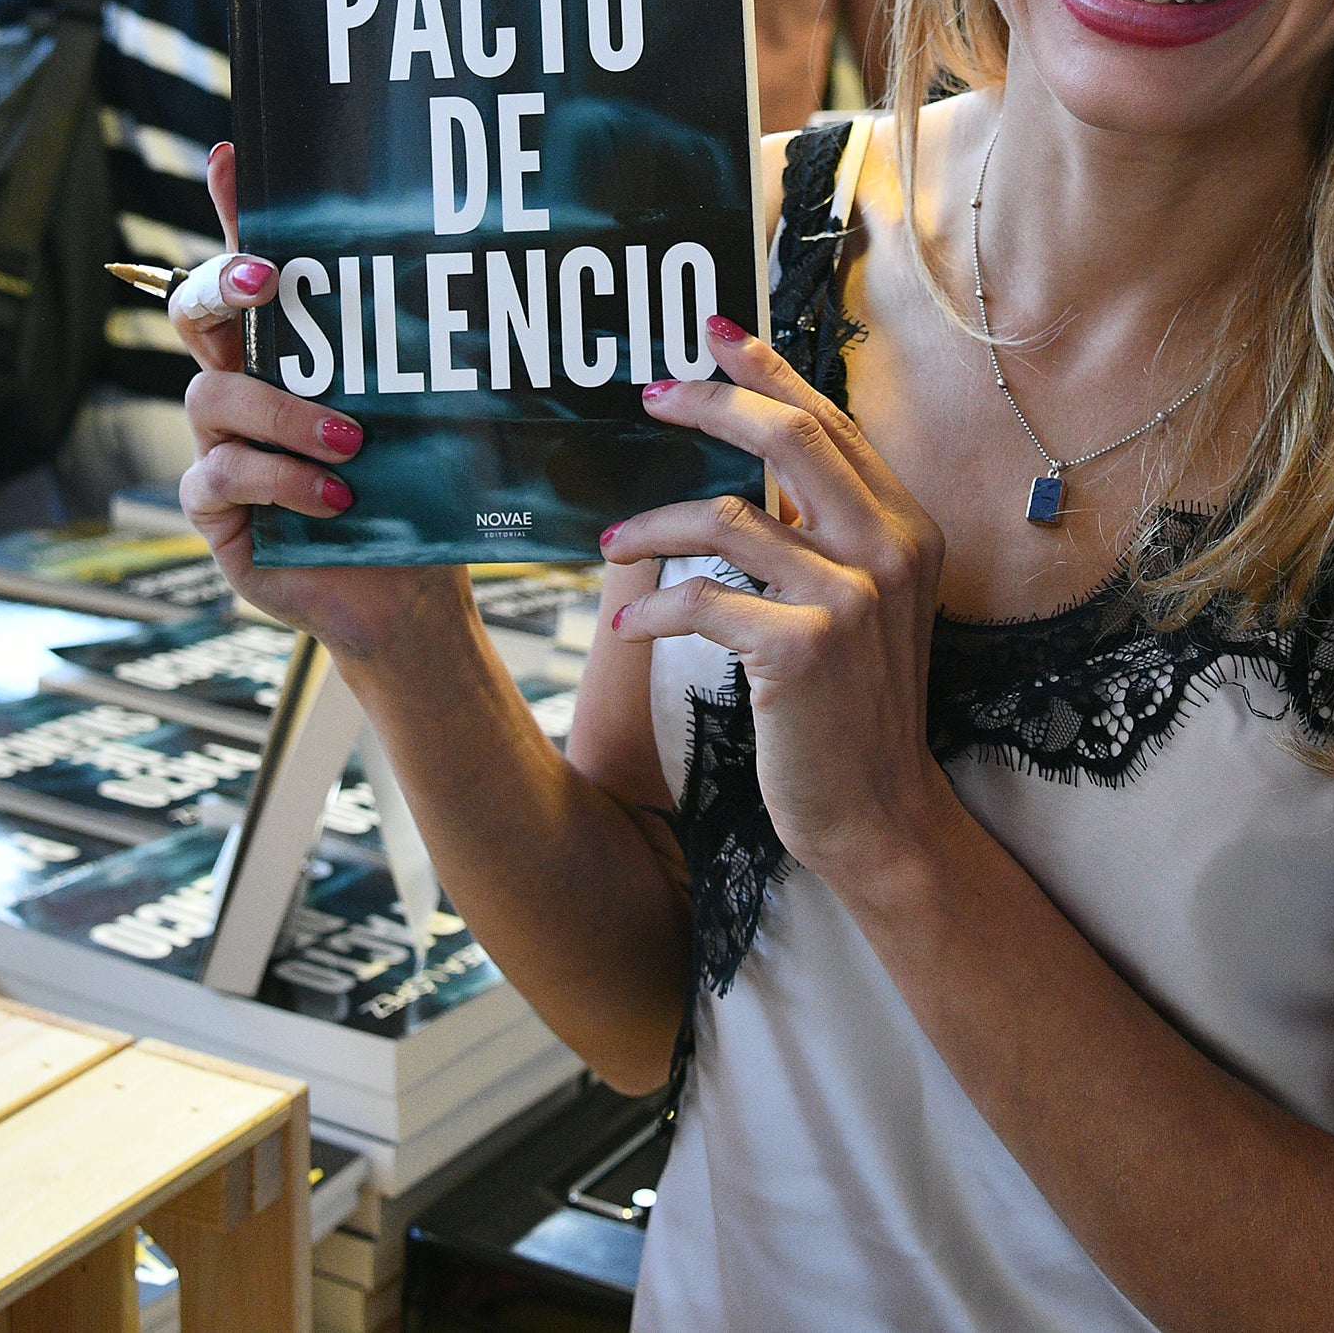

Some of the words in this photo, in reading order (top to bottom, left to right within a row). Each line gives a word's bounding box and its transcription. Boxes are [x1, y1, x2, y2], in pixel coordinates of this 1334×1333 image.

[429, 93, 550, 236] DE
[278, 241, 718, 398] SILENCIO
[476, 512, 532, 527] NOVAE
